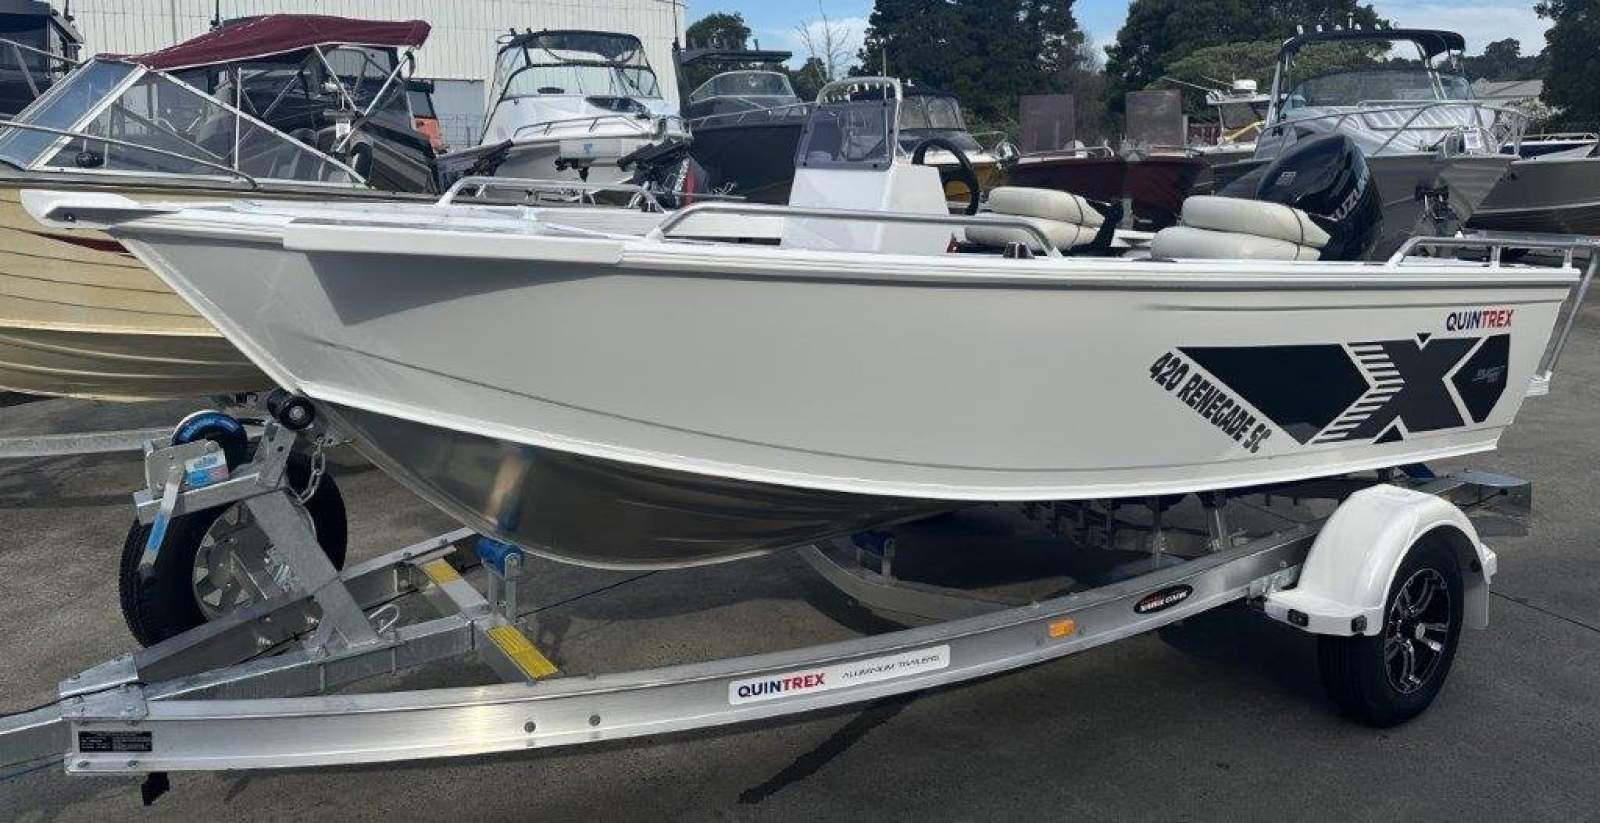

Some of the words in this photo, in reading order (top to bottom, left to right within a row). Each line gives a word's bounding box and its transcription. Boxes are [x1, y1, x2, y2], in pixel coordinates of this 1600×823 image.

[1446, 309, 1514, 331] QUINTREX
[1149, 352, 1189, 391] 420
[1176, 372, 1256, 441] RENEGADE
[1243, 423, 1272, 453] SC
[738, 673, 825, 698] QUINTREX
